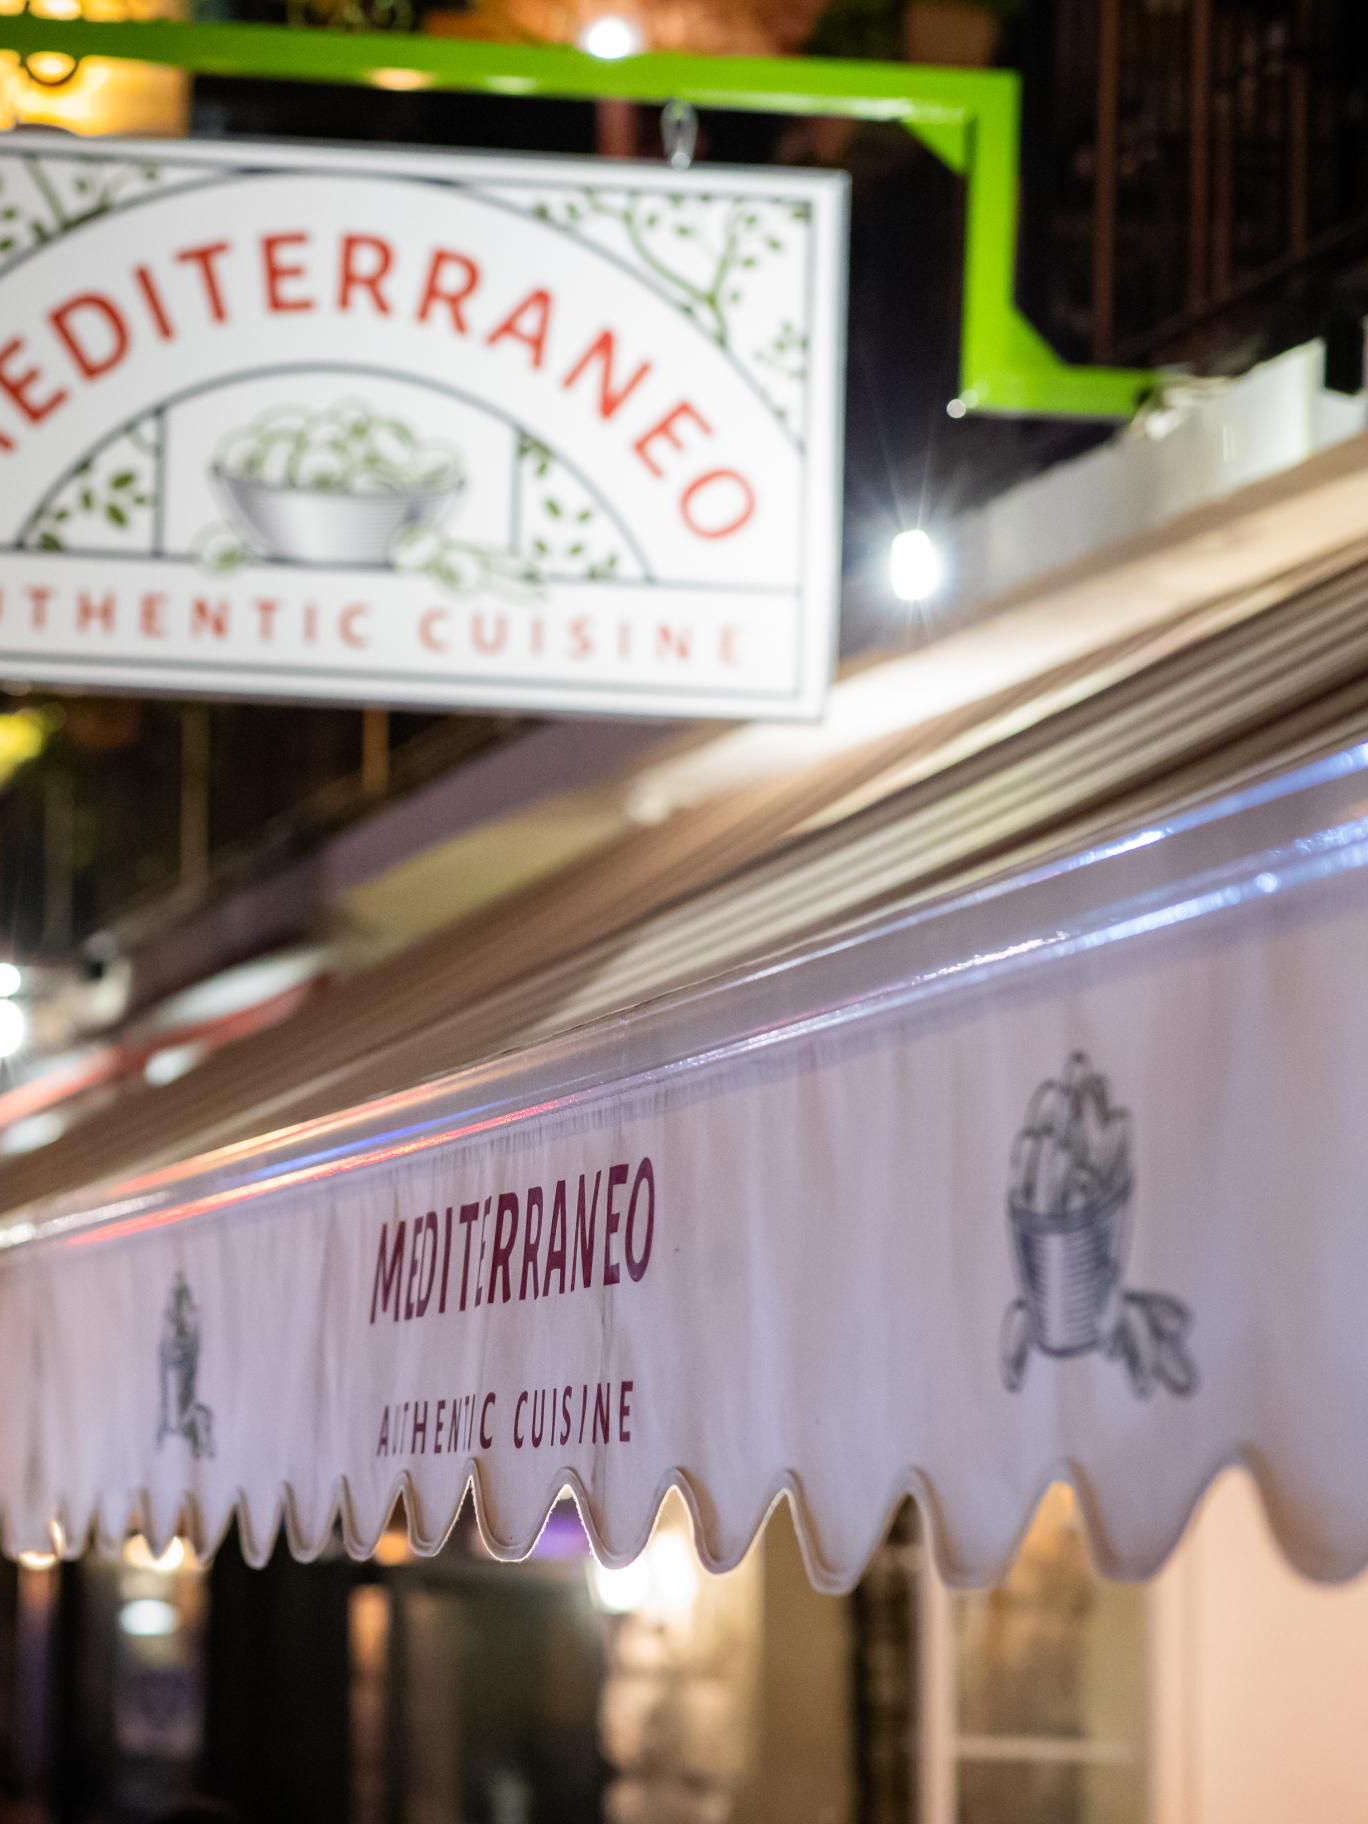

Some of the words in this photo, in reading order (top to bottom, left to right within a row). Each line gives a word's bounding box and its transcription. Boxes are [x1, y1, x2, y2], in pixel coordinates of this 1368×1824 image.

[417, 607, 744, 668] CUISINE
[369, 1156, 656, 1325] MEDITERRANEO
[513, 1380, 635, 1450] CUISINE
